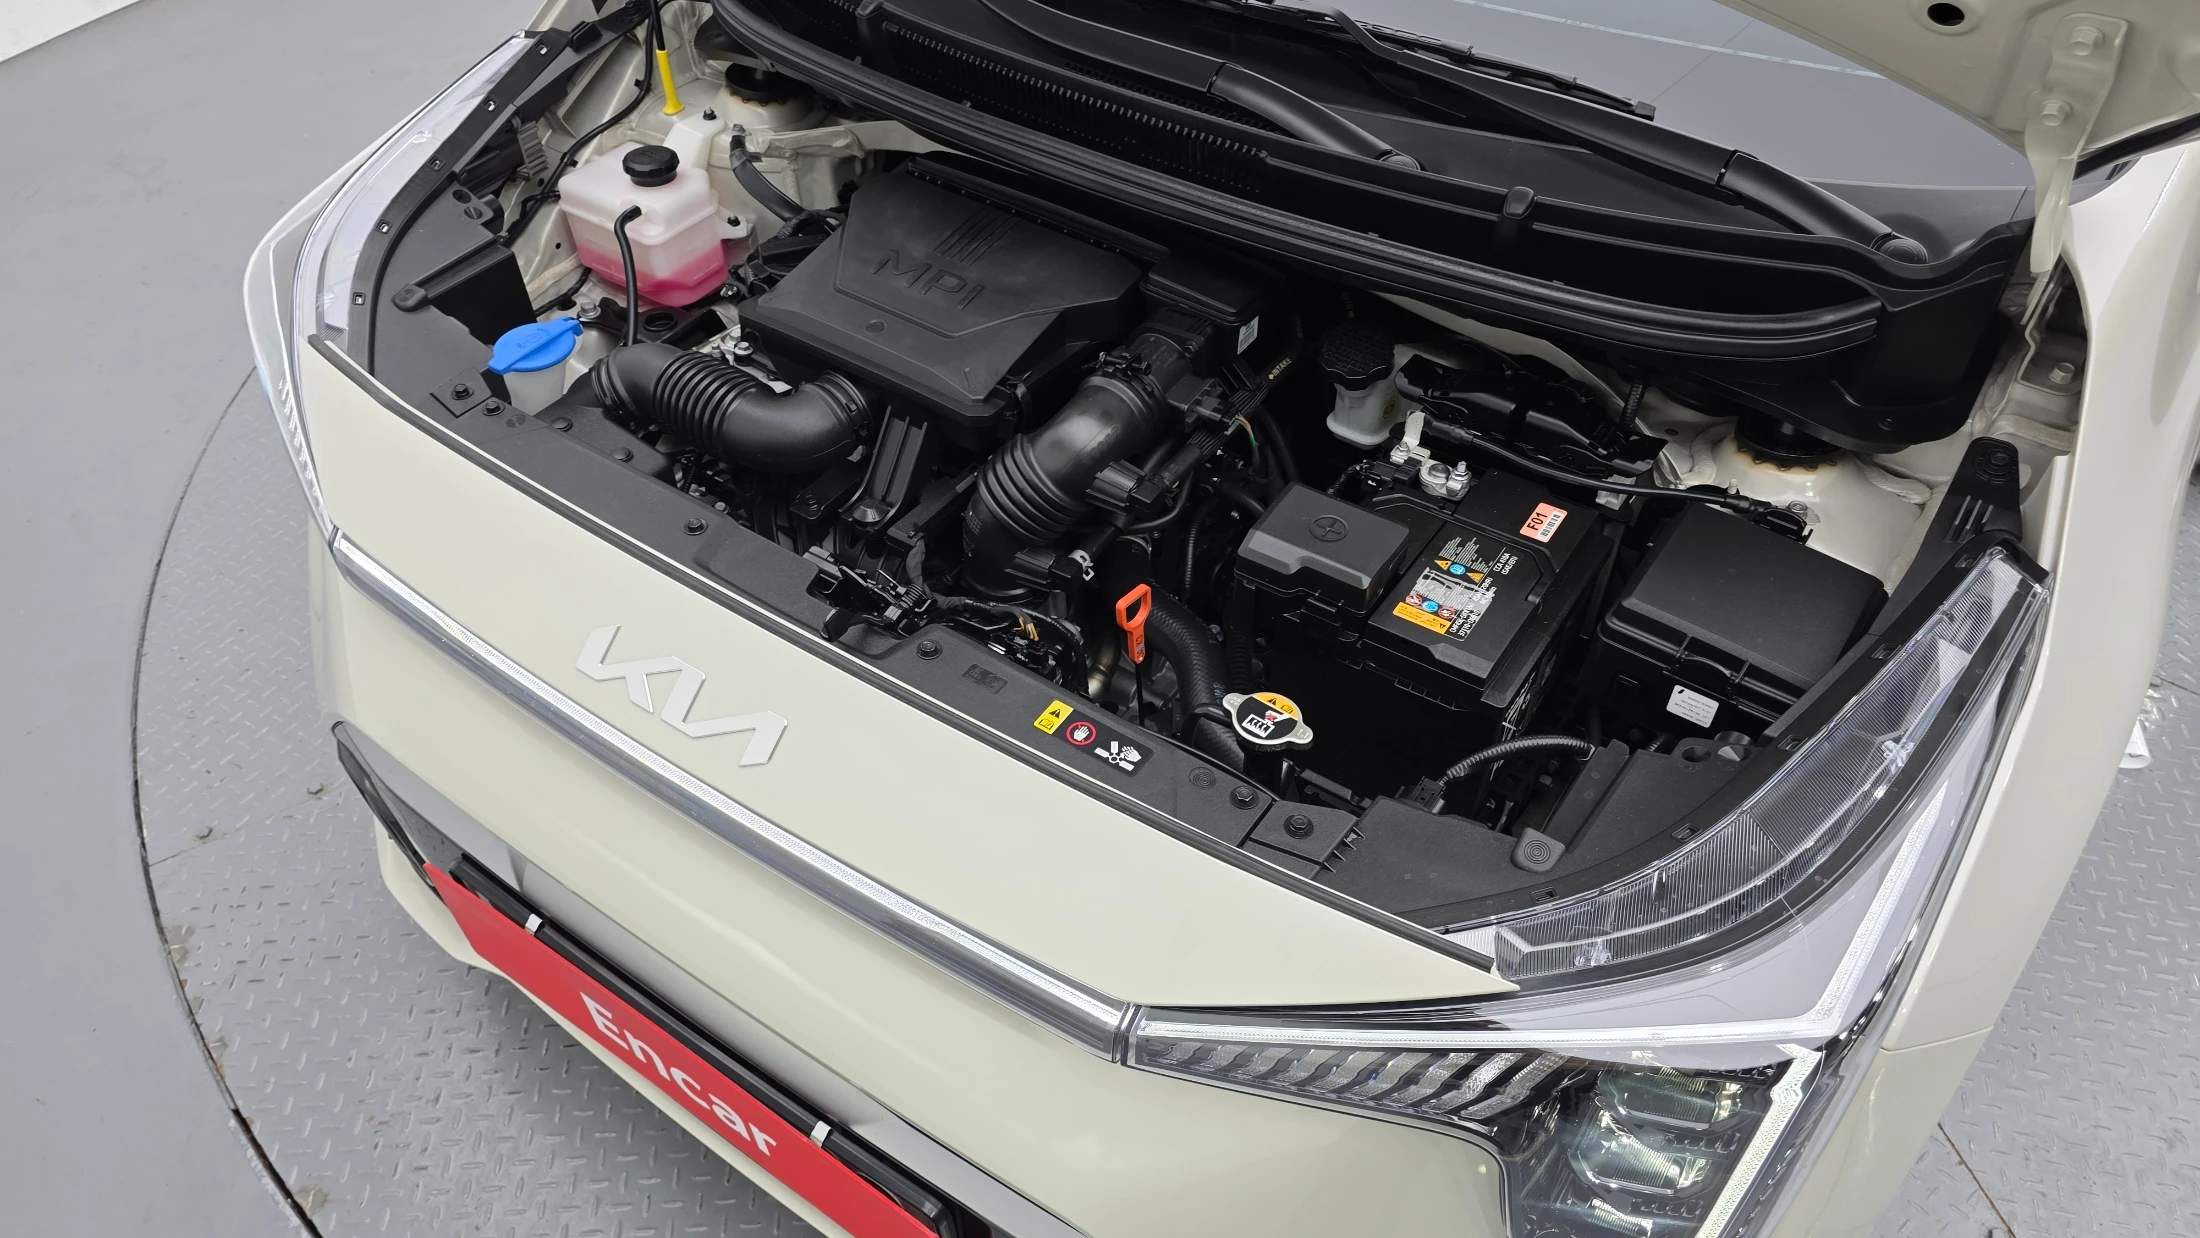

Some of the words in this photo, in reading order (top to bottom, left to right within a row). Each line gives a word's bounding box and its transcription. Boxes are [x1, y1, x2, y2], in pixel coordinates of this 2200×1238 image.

[869, 249, 986, 311] MPI
[1271, 356, 1293, 377] INTAKE
[1526, 511, 1548, 531] F01
[580, 991, 777, 1157] Encar
